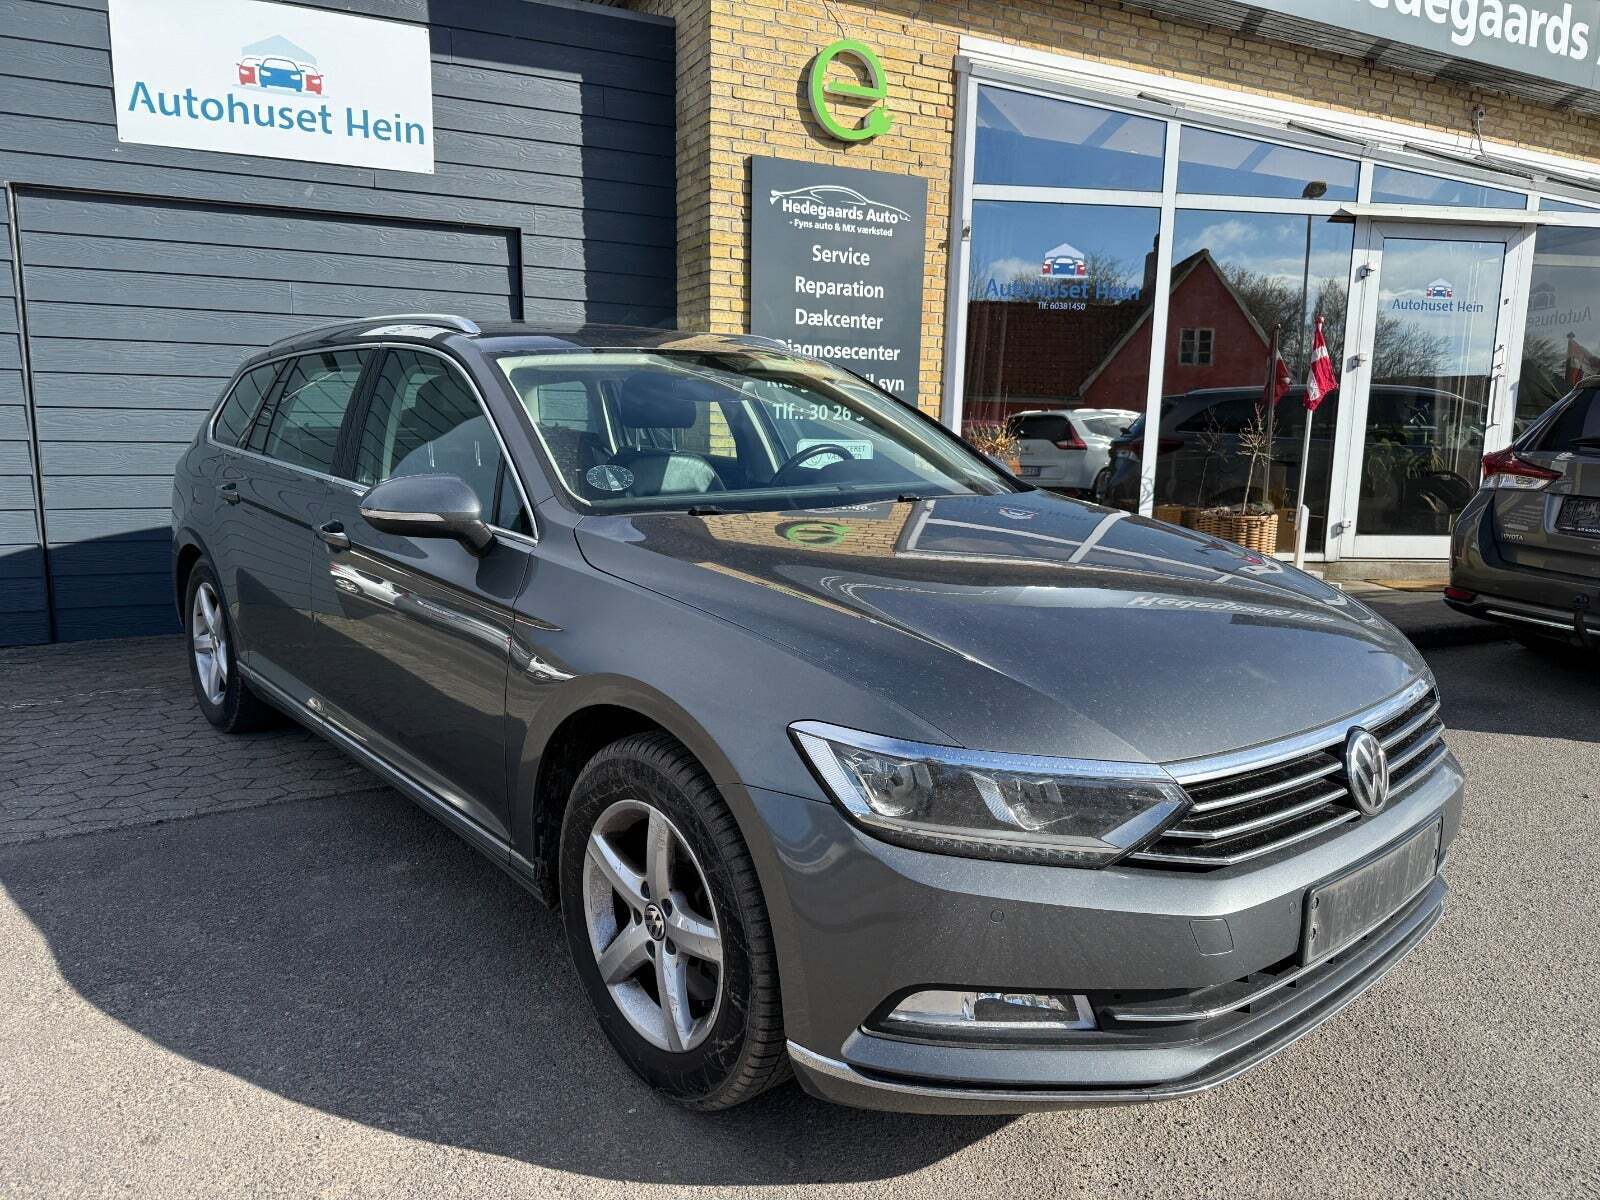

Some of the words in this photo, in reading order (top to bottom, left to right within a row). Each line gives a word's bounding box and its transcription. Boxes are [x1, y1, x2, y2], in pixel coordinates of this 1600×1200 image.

[128, 81, 333, 134] Autohuset
[346, 107, 425, 145] Hein
[782, 199, 864, 220] Hedegaards
[866, 208, 899, 224] Auto
[794, 218, 813, 230] Fyns
[814, 221, 833, 231] auto
[834, 222, 841, 232] &
[842, 223, 856, 233] MX
[857, 225, 893, 237] værksted
[812, 244, 871, 266] Service
[795, 275, 885, 299] Reparation
[984, 277, 1089, 299] Autohuset
[1095, 281, 1140, 300] Hein
[1392, 298, 1454, 312] Autohuset
[1457, 300, 1484, 313] Hein
[795, 308, 884, 330] Dækcenter
[879, 378, 905, 393] syn
[809, 405, 828, 420] 30
[832, 405, 852, 421] 26
